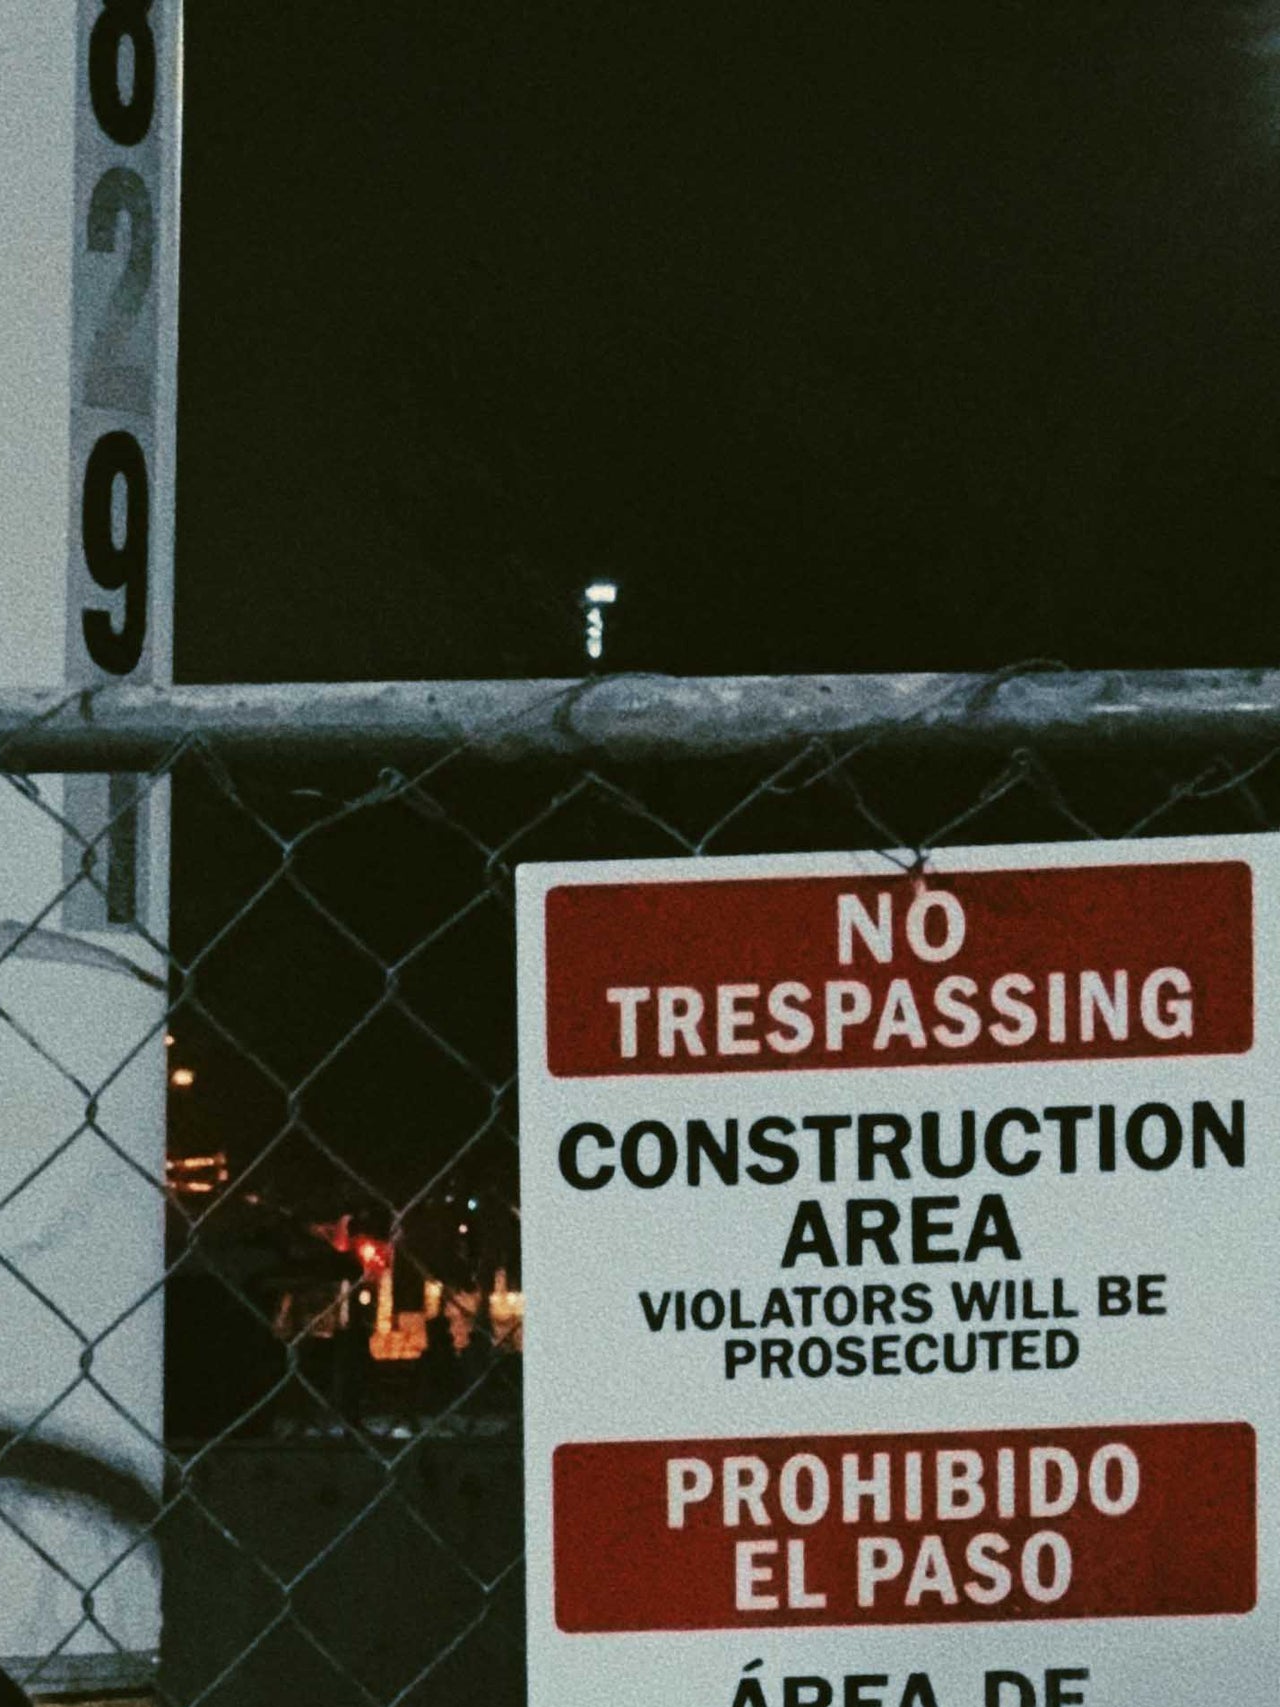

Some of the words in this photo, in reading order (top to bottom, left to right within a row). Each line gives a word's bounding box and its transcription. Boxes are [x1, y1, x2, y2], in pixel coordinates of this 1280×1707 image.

[838, 889, 966, 965] NO
[606, 966, 1194, 1059] TRESPASSING
[557, 1099, 1246, 1190] CONSTRUCTION
[780, 1193, 1022, 1269] AREA
[638, 1283, 934, 1332] VIOLATORS
[950, 1278, 1079, 1321] WILL
[1098, 1274, 1168, 1317] BE
[723, 1329, 1080, 1380] PROSECUTED
[666, 1443, 1140, 1530] PROHIBIDO
[735, 1539, 827, 1611] EL
[856, 1530, 1072, 1607] PASO
